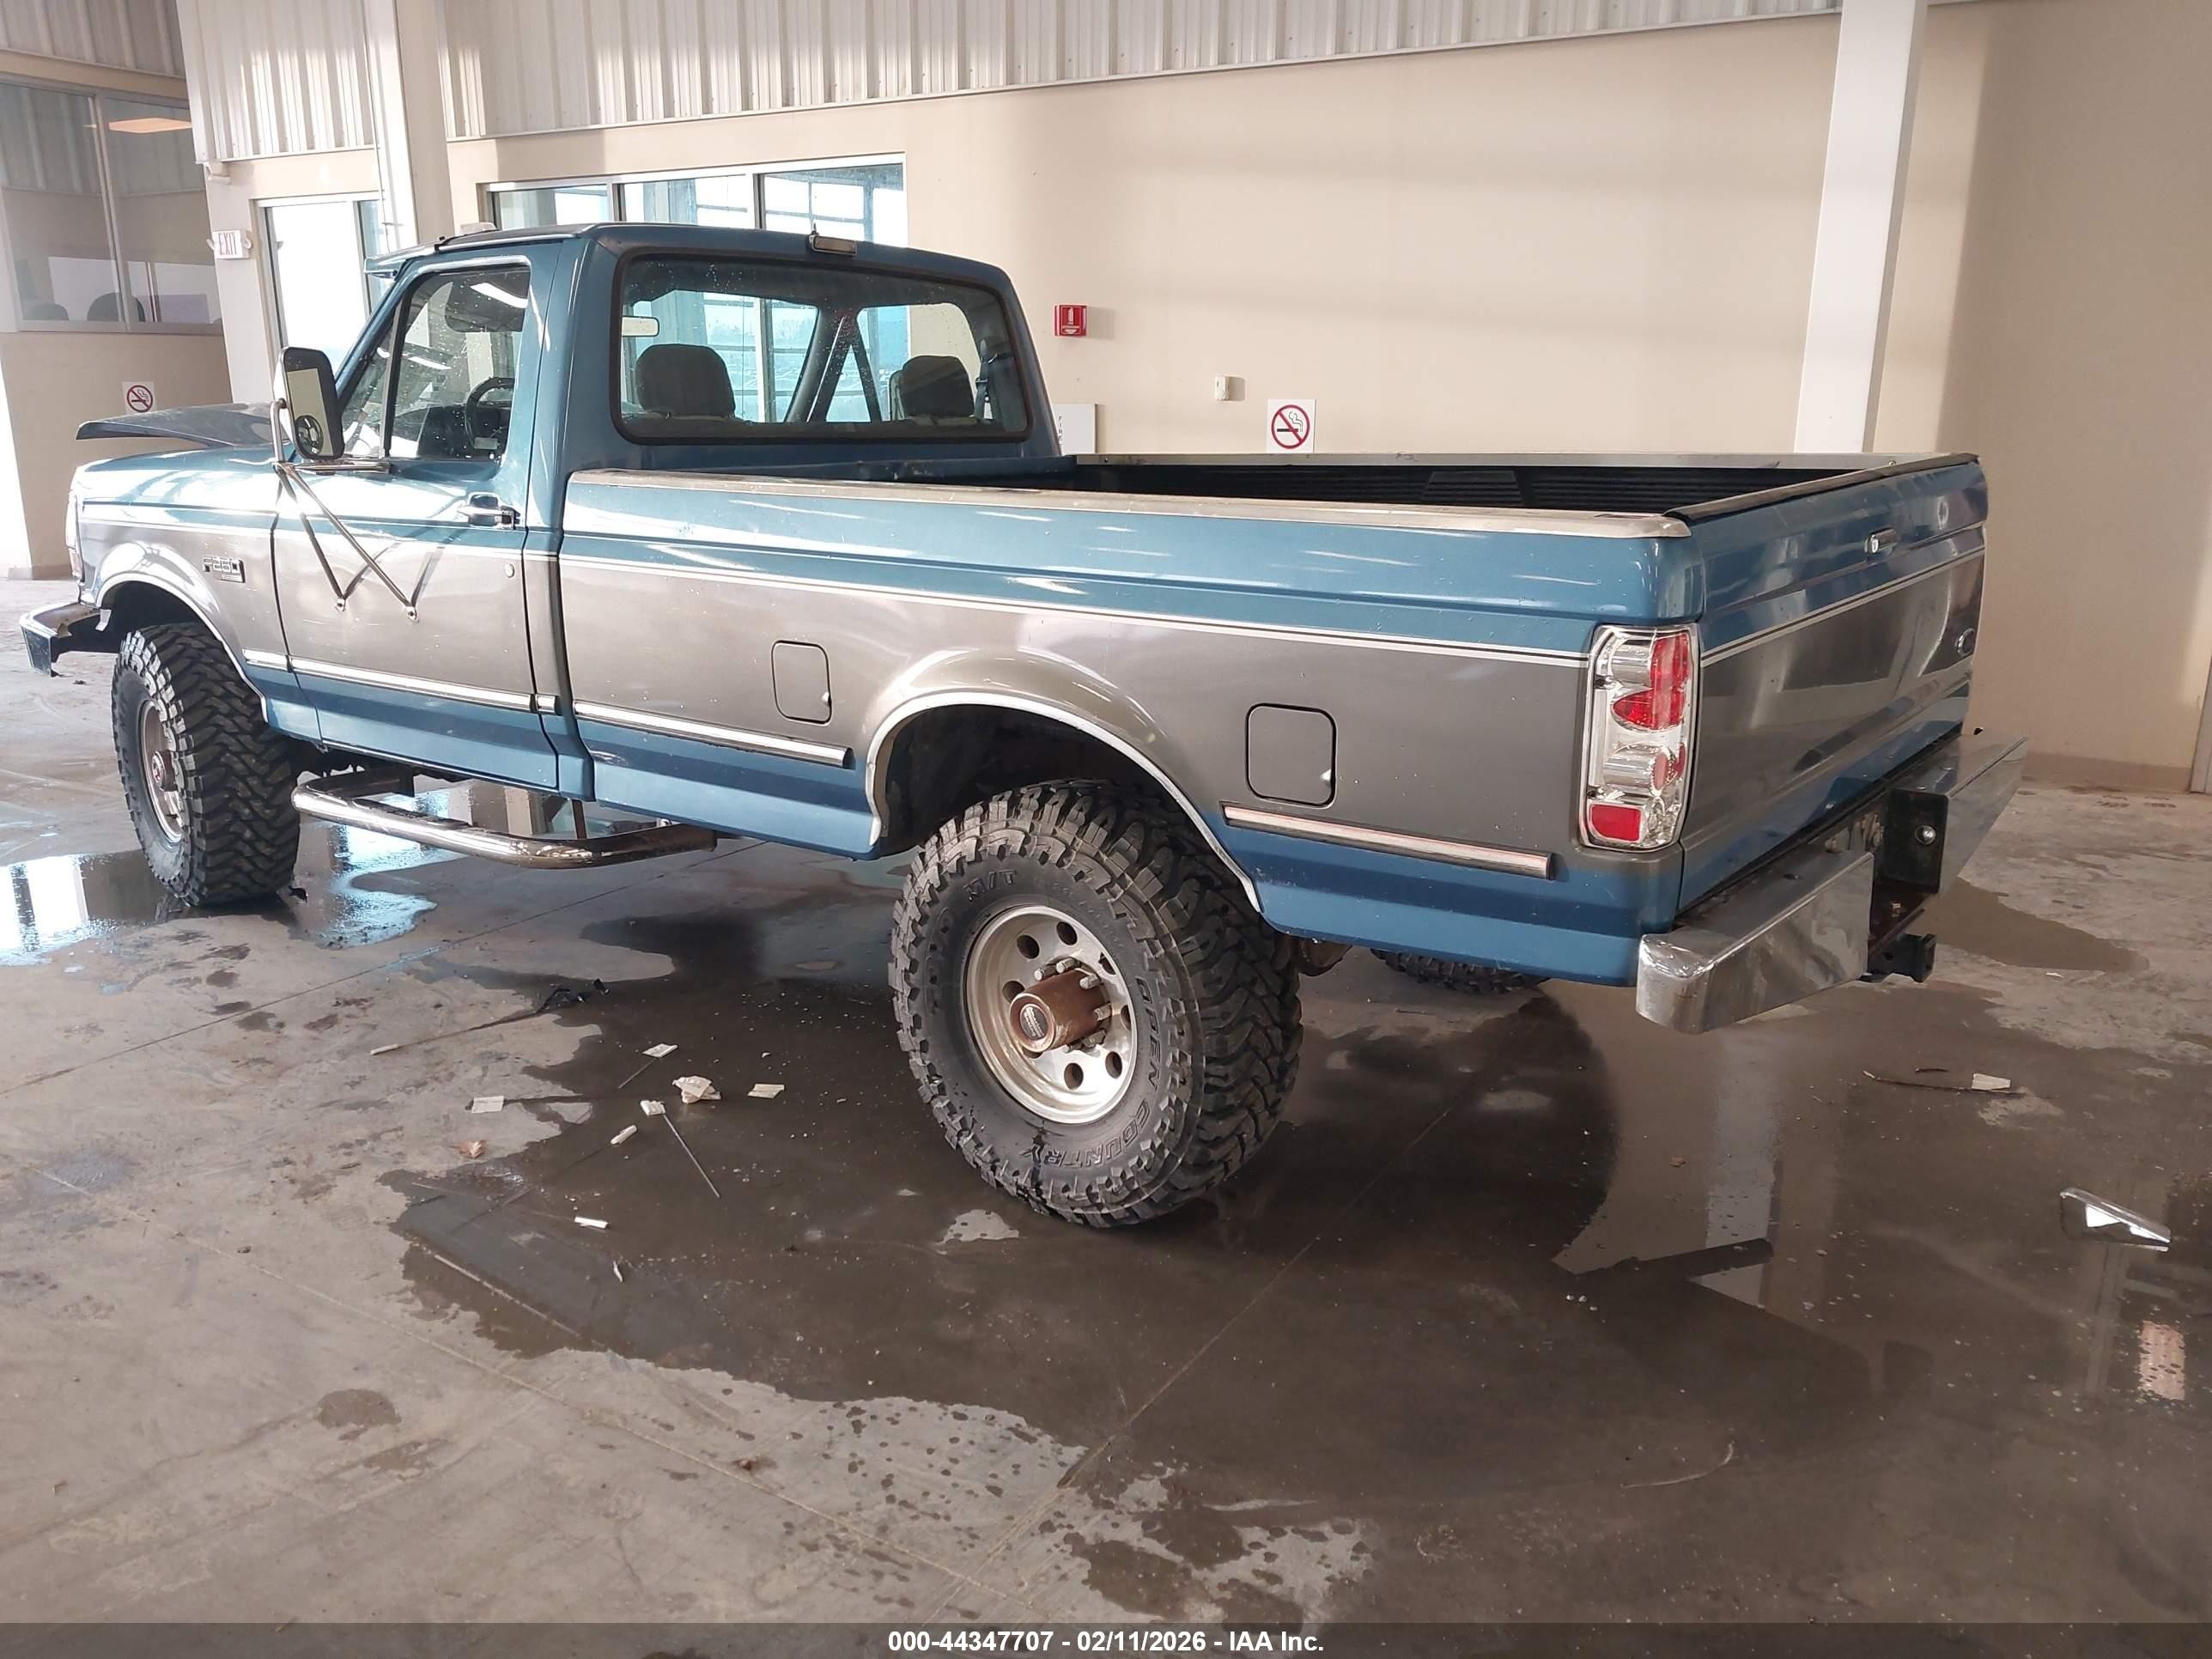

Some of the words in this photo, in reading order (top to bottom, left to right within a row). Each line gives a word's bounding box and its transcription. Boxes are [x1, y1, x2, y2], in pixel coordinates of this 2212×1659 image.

[218, 232, 237, 255] EXIT
[963, 869, 1017, 902] M/T
[1135, 976, 1162, 1091] OPEN
[1020, 1099, 1151, 1168] COUNTRY
